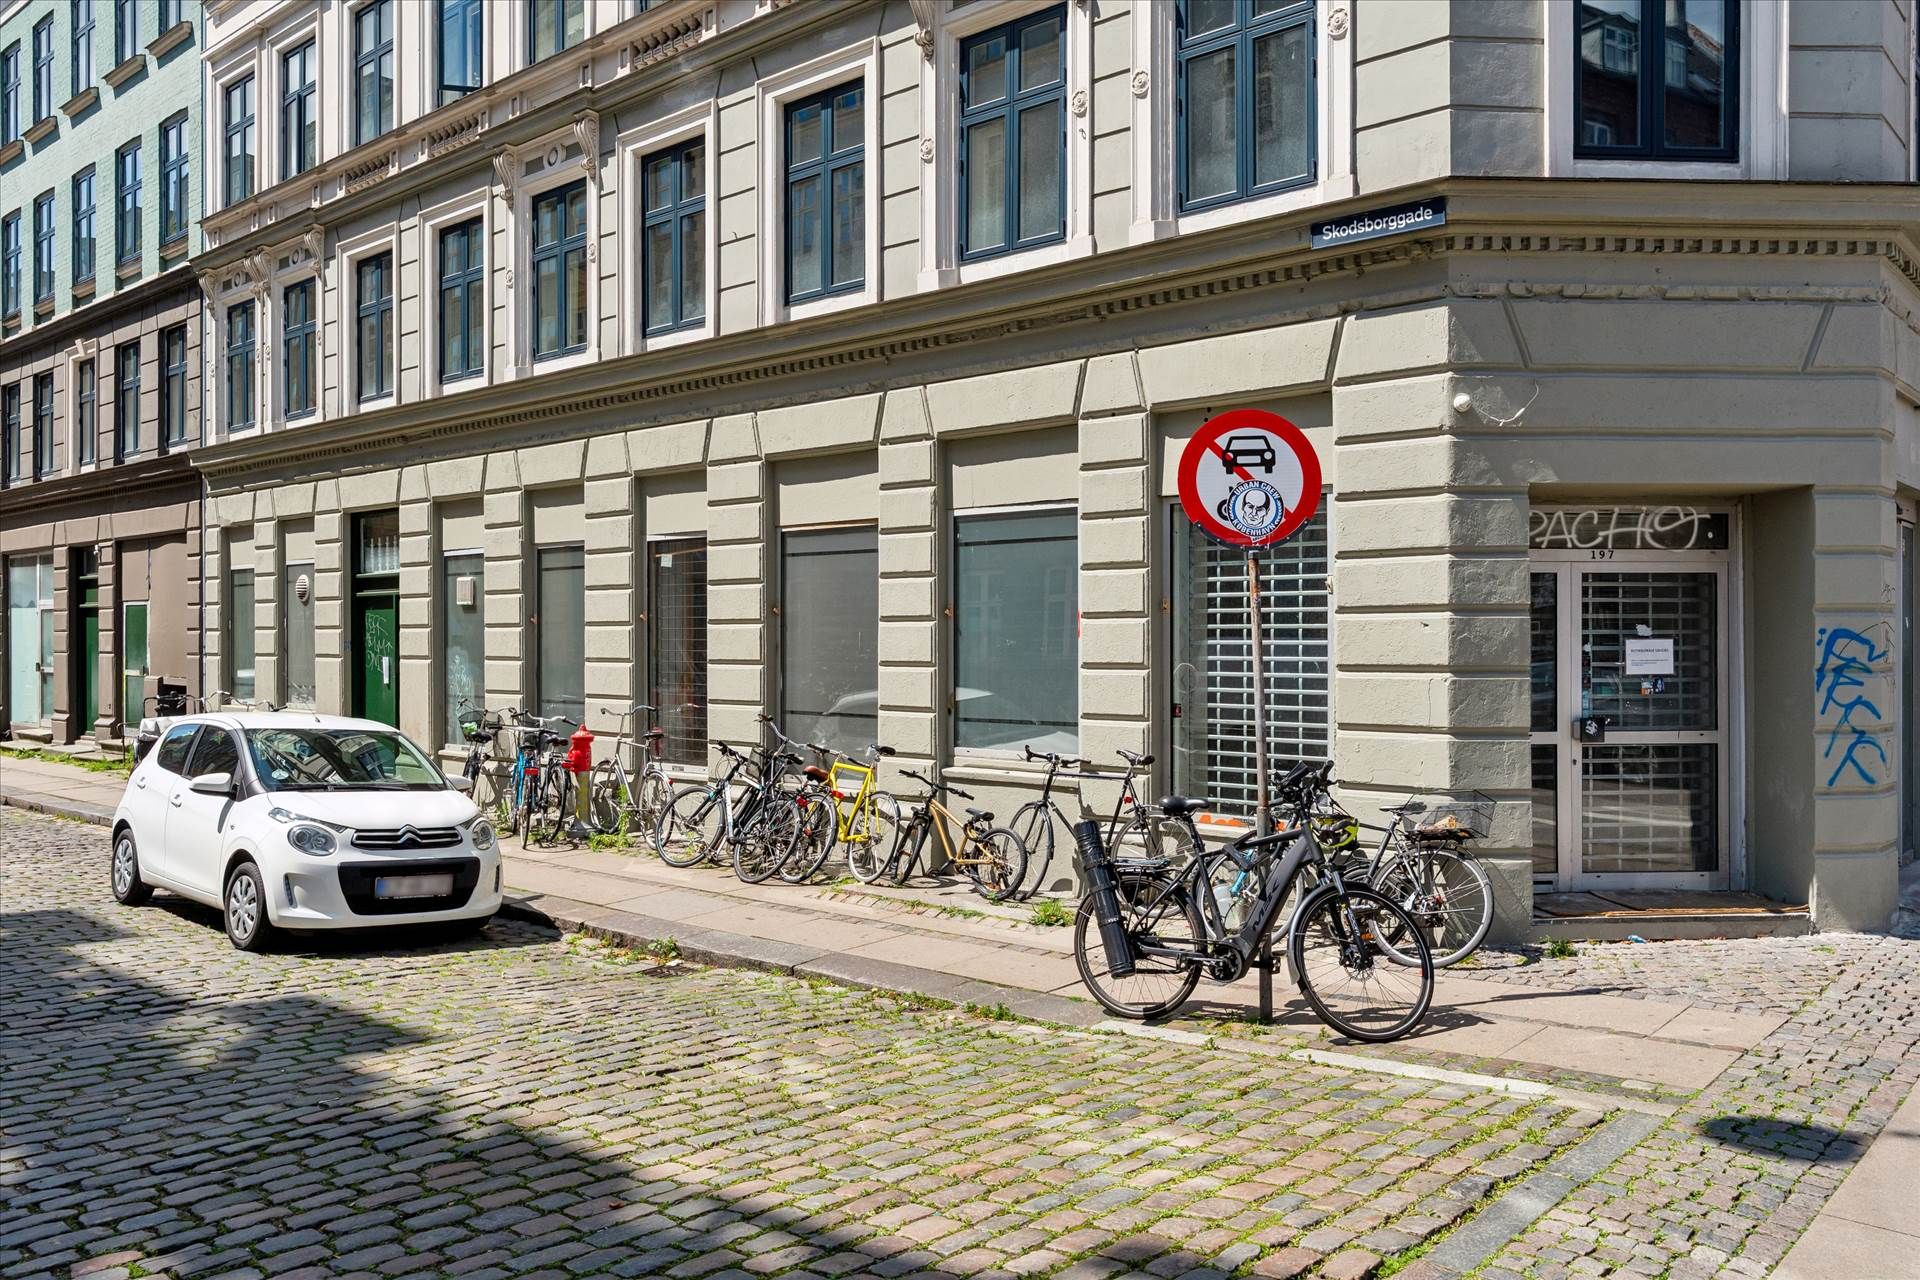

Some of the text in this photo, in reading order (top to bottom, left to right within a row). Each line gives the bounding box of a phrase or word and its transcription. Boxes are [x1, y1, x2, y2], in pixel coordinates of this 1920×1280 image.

[1322, 206, 1433, 240] Skodsborggade
[1234, 481, 1281, 501] URBAN CREW
[1591, 550, 1614, 560] 197
